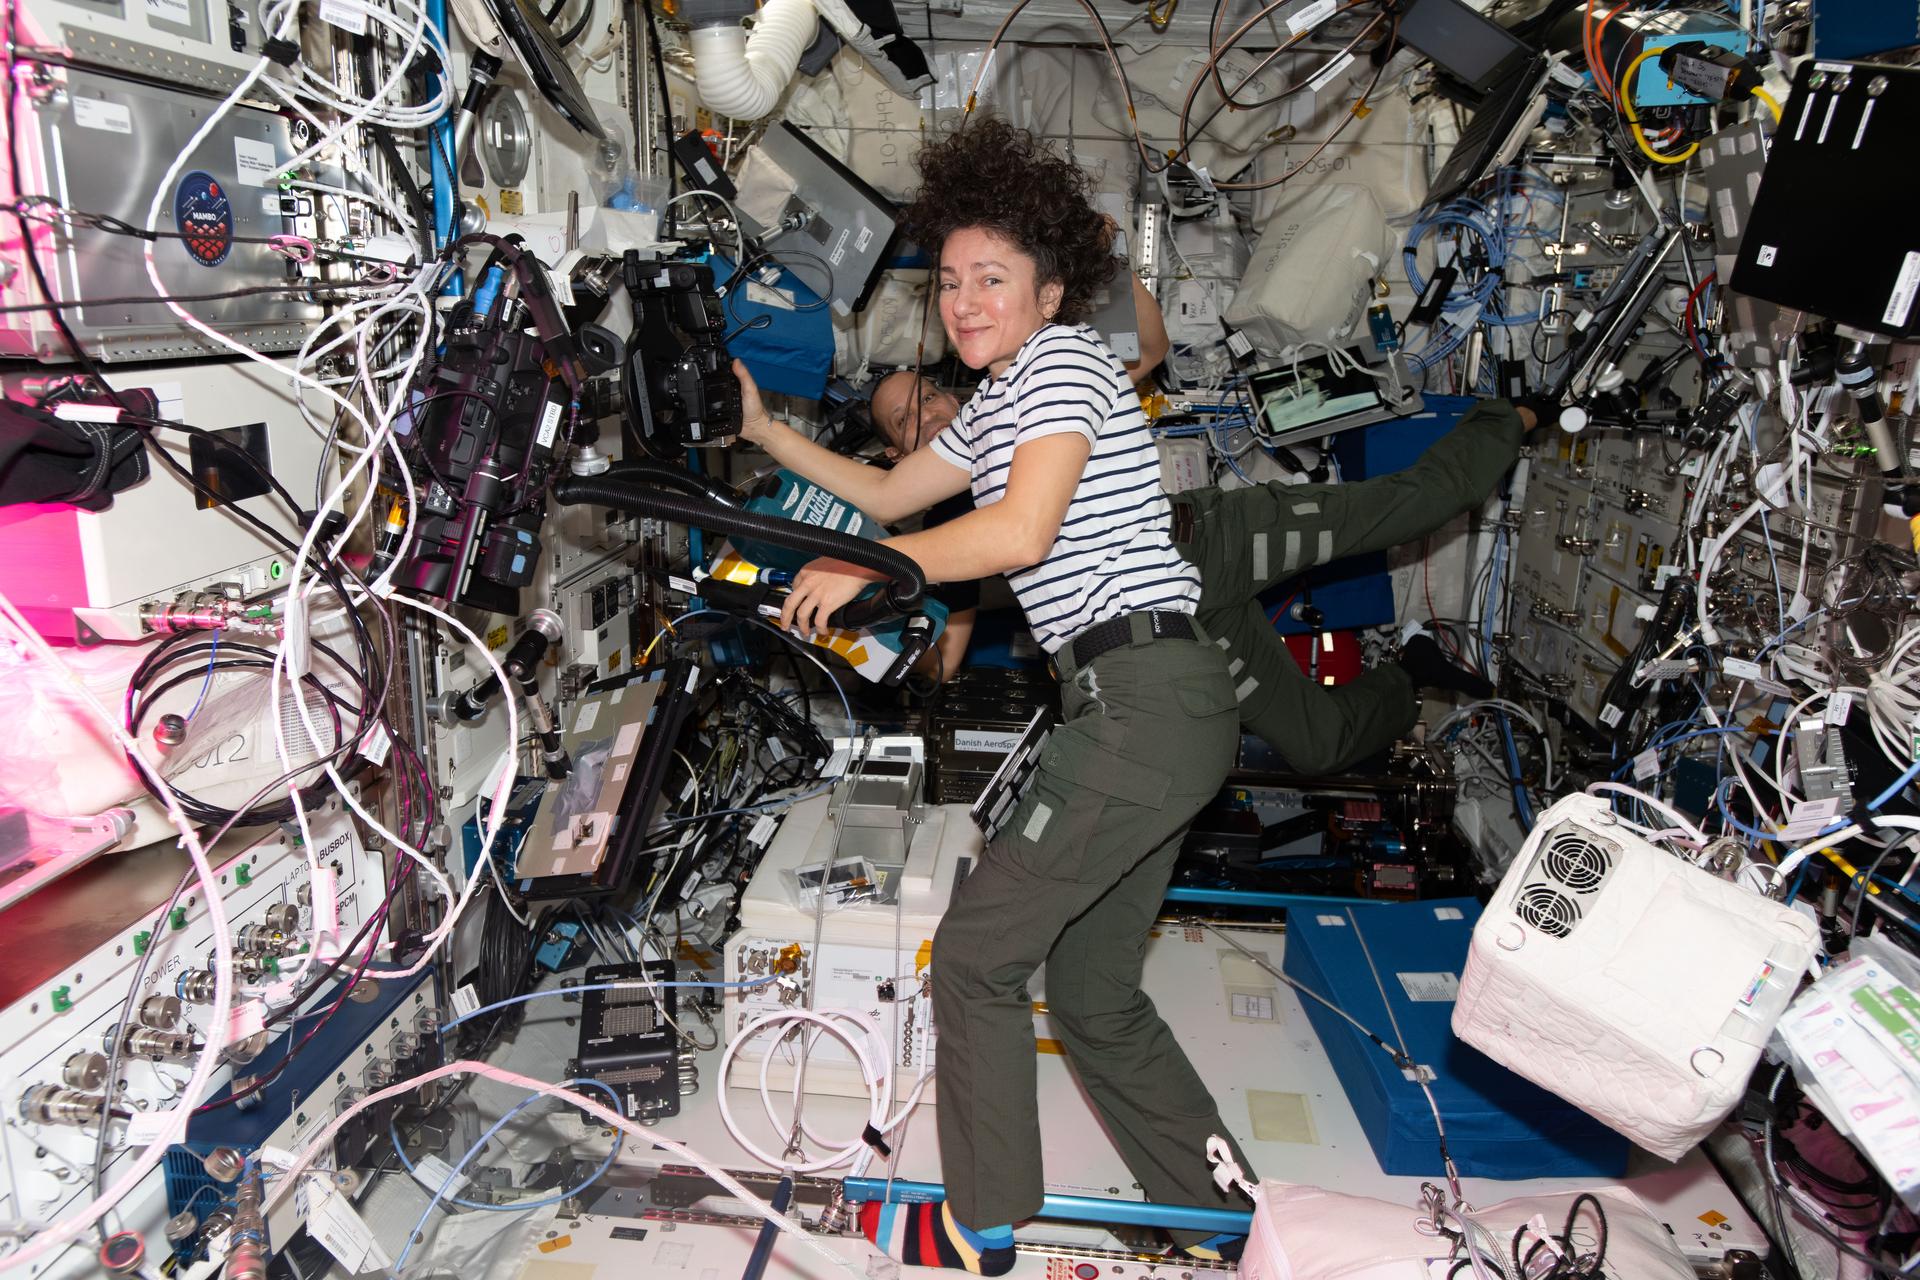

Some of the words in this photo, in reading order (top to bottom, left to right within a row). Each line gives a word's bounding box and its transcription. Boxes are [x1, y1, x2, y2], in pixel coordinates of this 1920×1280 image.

[193, 212, 217, 220] MAMBO
[541, 424, 552, 443] VCA2
[956, 738, 982, 747] Danish
[319, 831, 351, 862] BUSBOX
[144, 954, 182, 989] POWER
